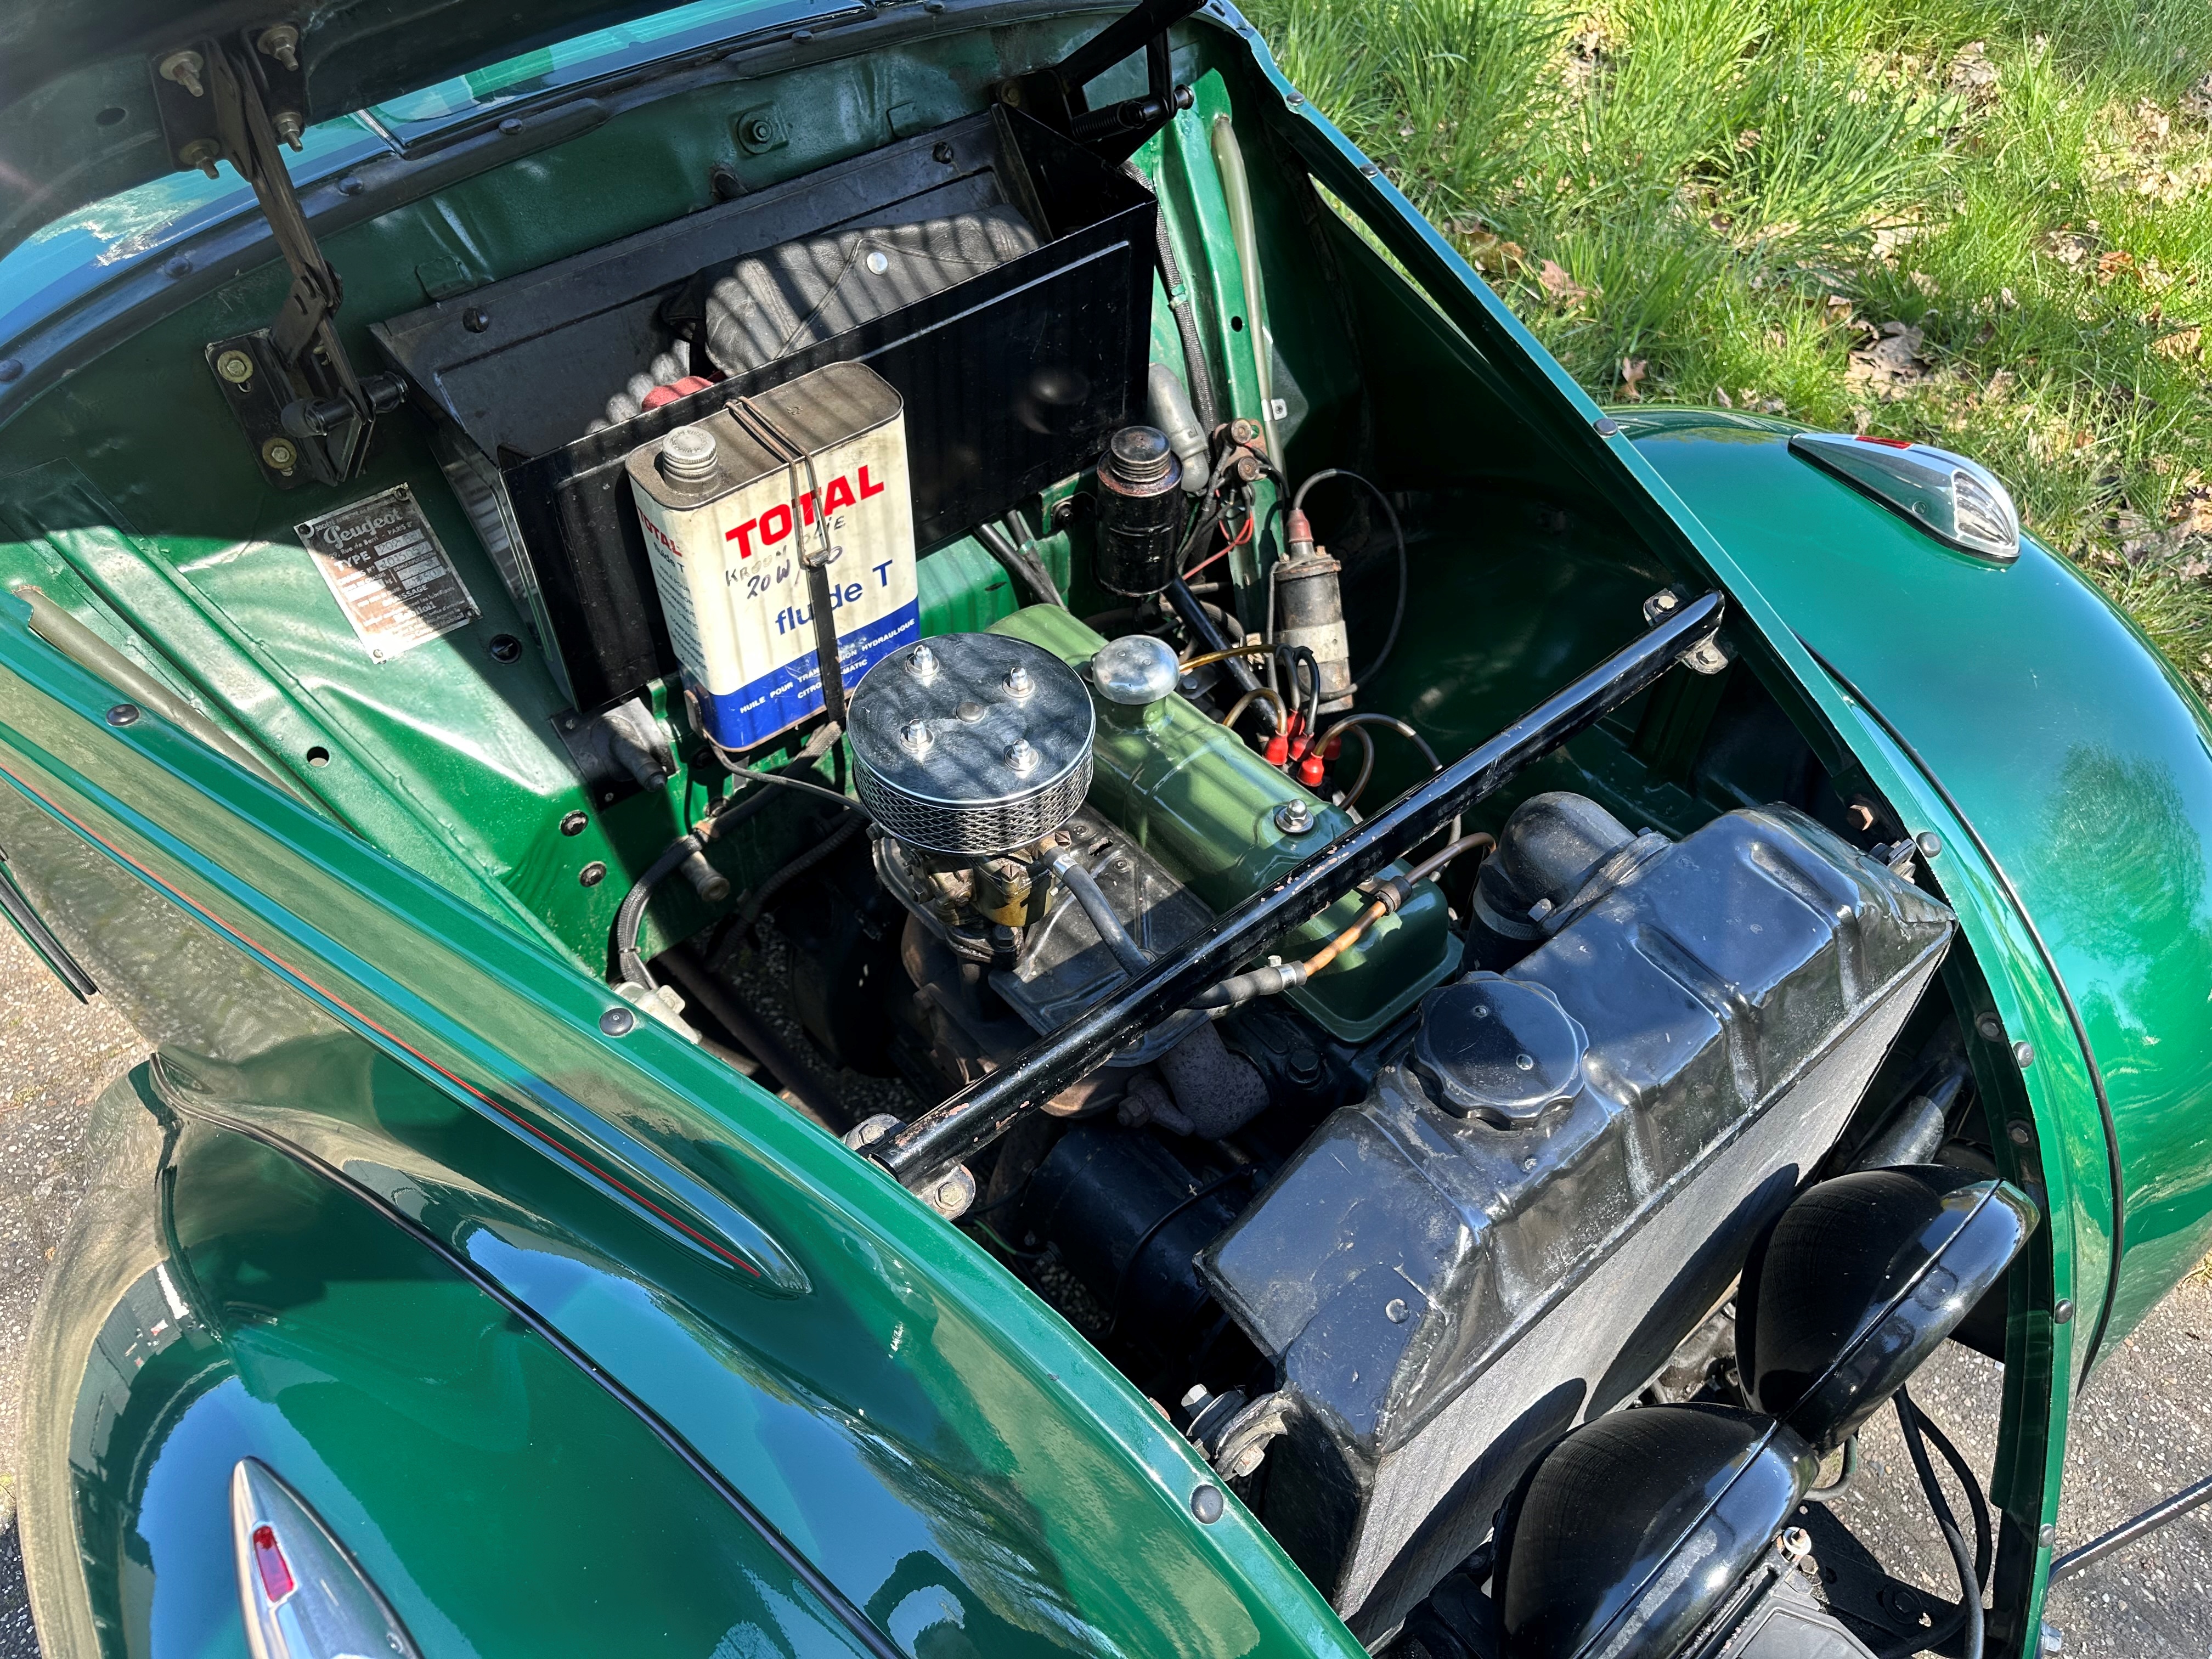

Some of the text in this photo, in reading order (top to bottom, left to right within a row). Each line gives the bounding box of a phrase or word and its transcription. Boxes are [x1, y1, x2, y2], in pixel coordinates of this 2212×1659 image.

[314, 519, 336, 532] SOCIÉTÉ
[323, 507, 403, 550] Peugeot
[637, 505, 682, 557] TOTAL
[725, 465, 884, 560] TOTAL
[340, 545, 353, 554] Rue
[352, 540, 363, 549] de
[362, 535, 379, 545] Berri
[387, 523, 407, 535] PARIS
[333, 550, 371, 572] TYPE
[677, 562, 684, 573] T
[726, 545, 787, 586] KROON
[775, 559, 893, 636] flude T
[740, 618, 915, 714] HUILE POUR TRANION HYDRAULIQUE
